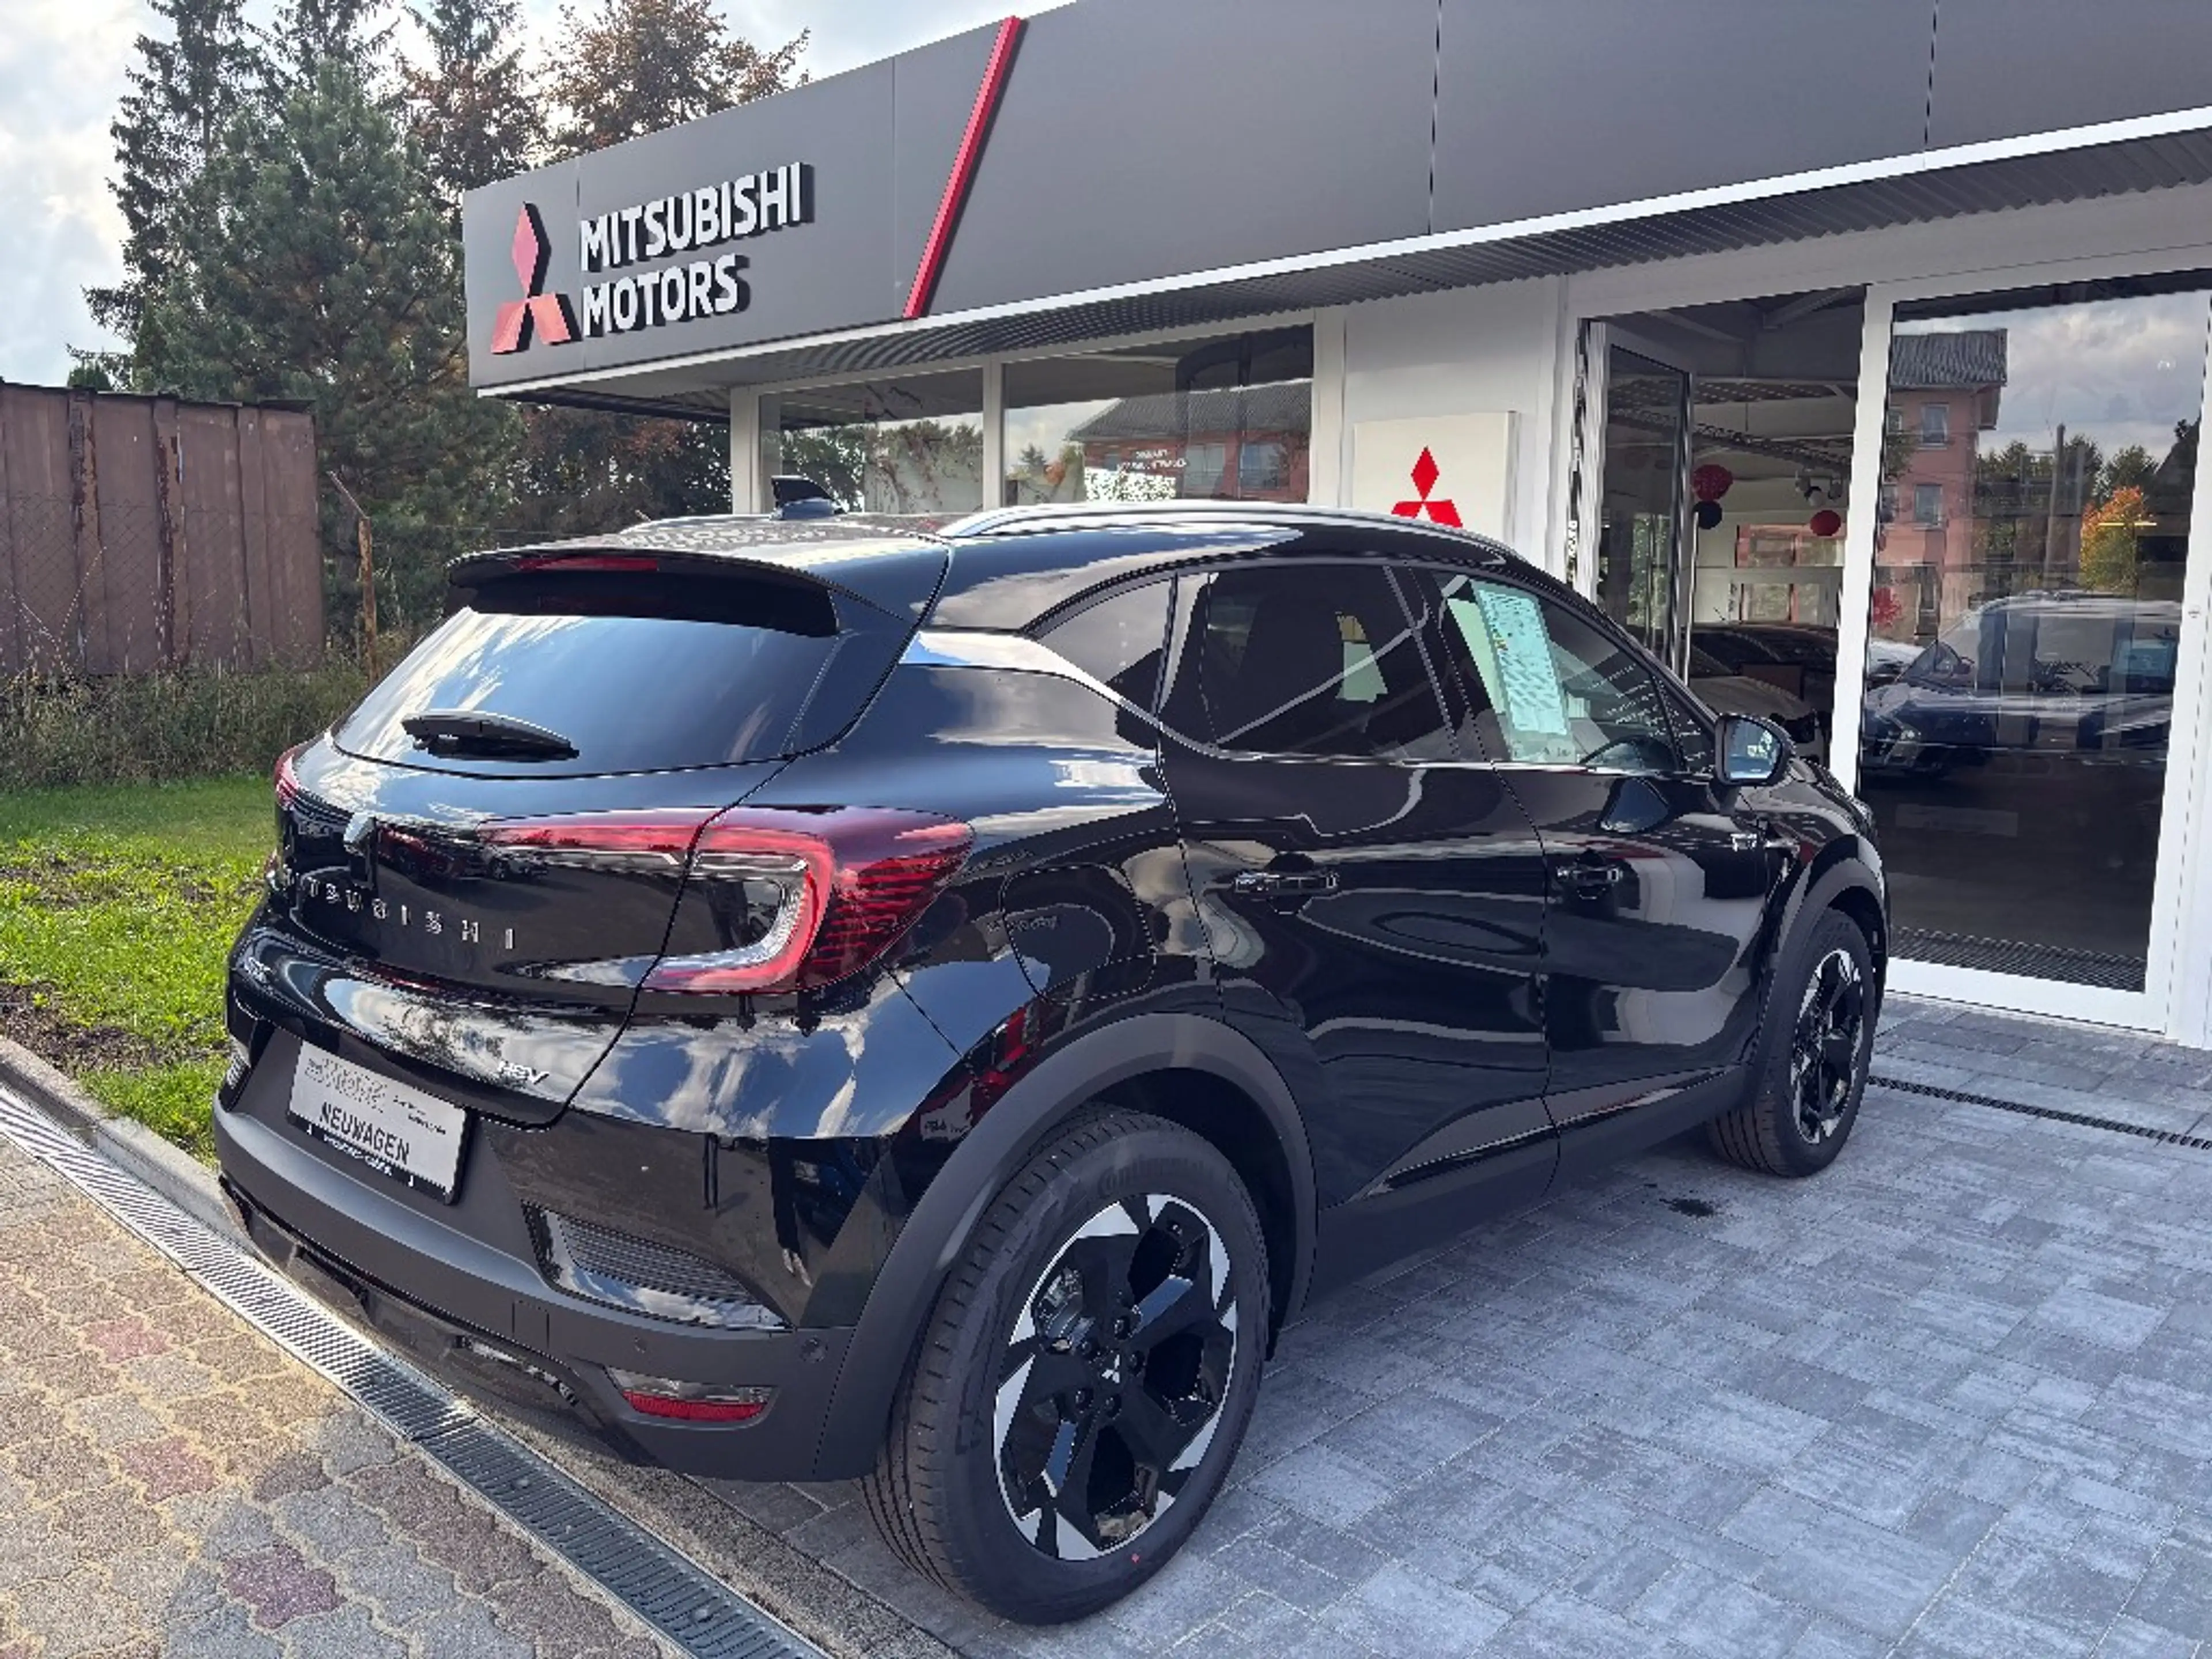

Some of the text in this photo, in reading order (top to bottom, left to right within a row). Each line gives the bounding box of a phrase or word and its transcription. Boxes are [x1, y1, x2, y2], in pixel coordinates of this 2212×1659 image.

[581, 162, 804, 271] MITSUBISHI
[583, 253, 741, 337] MOTORS
[287, 869, 513, 949] TSUBISHI
[320, 1101, 410, 1165] NEUWAGEN
